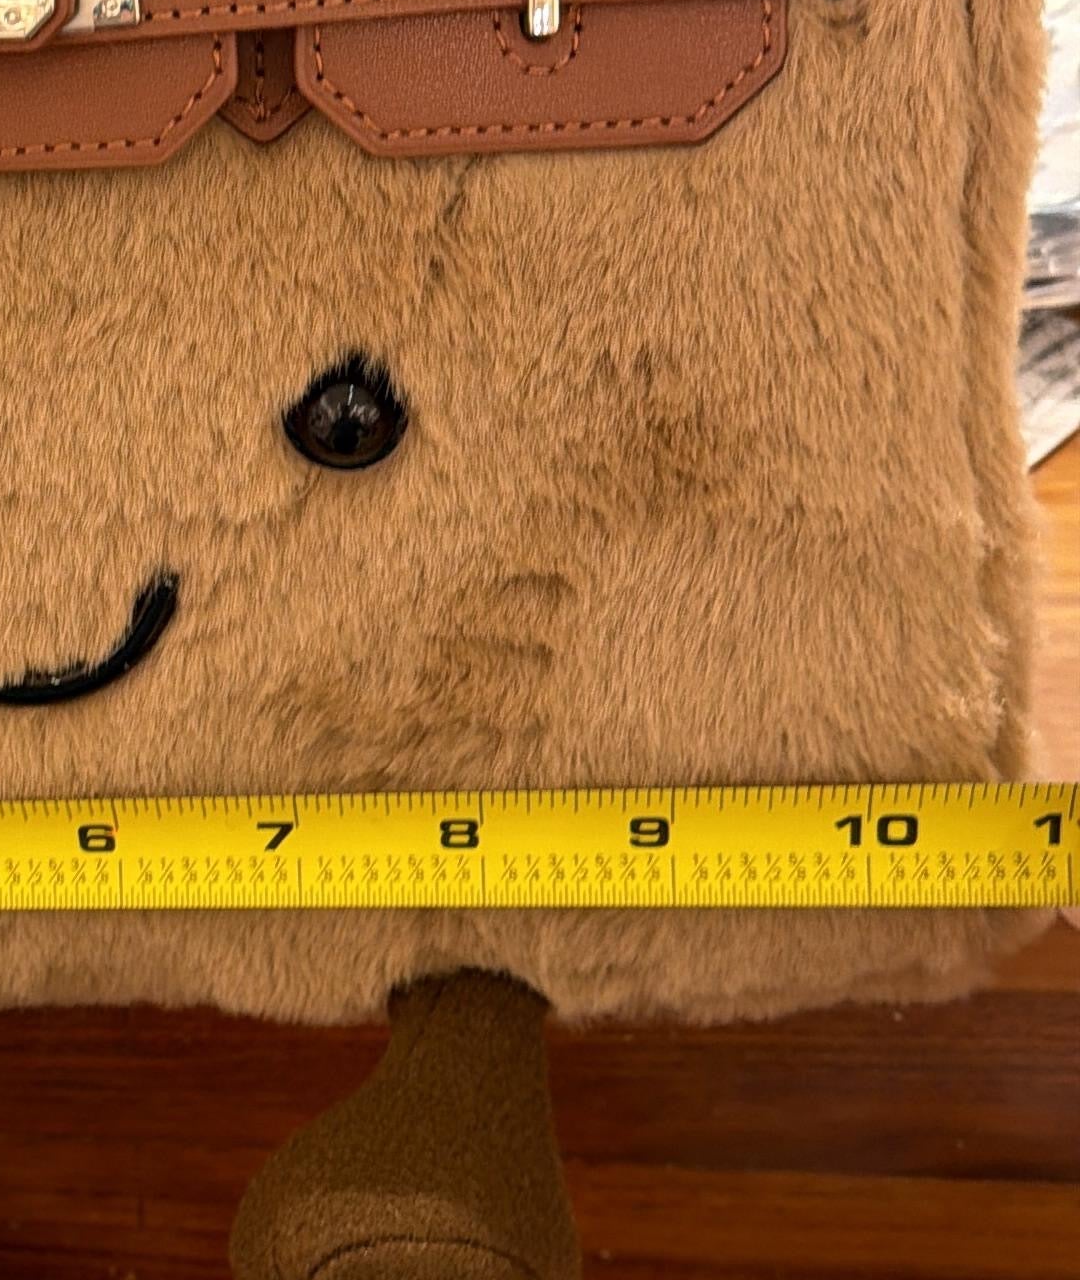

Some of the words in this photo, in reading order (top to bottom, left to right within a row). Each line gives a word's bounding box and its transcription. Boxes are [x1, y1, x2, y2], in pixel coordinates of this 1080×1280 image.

[77, 823, 116, 852] 6
[256, 821, 295, 852] 7
[439, 818, 480, 849] 8
[629, 816, 670, 848] 9
[835, 813, 919, 847] 10
